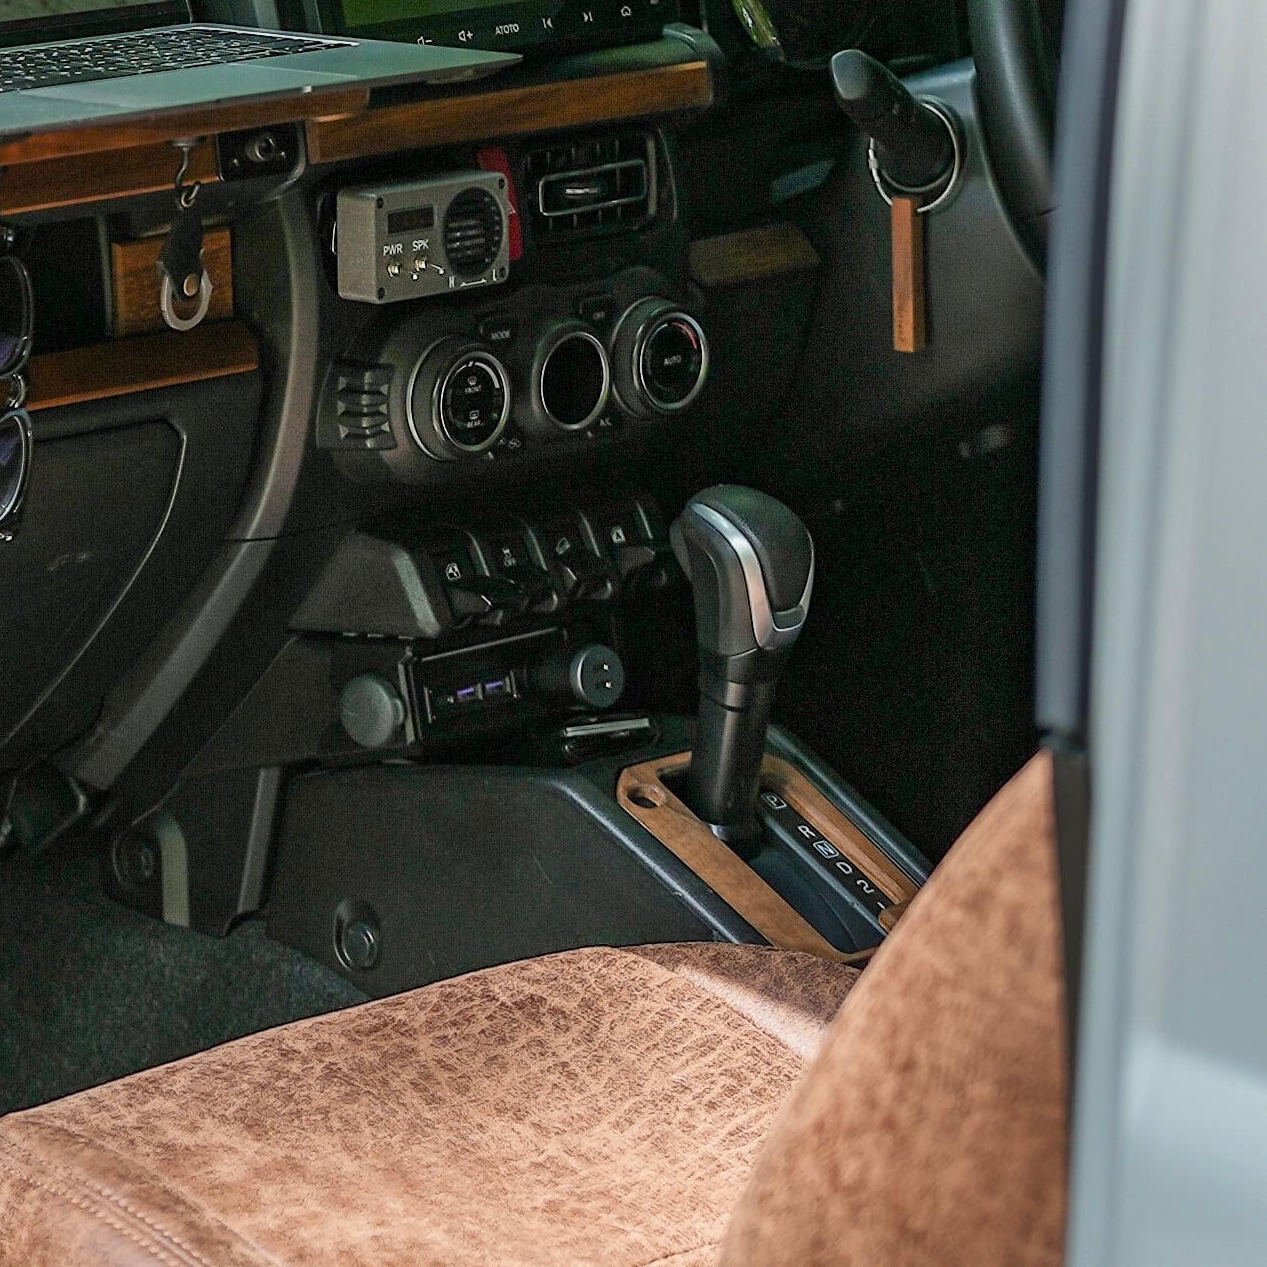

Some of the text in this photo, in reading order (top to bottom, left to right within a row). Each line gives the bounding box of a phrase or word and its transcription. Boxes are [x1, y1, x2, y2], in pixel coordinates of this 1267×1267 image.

[495, 23, 519, 36] ATOTO
[383, 243, 403, 256] PWR
[412, 238, 429, 252] SPK
[449, 275, 455, 288] H
[491, 329, 510, 340] MODE
[663, 354, 682, 367] AUTO
[465, 385, 482, 394] FRONT
[797, 824, 816, 838] R
[835, 861, 852, 875] D
[856, 879, 875, 894] 2
